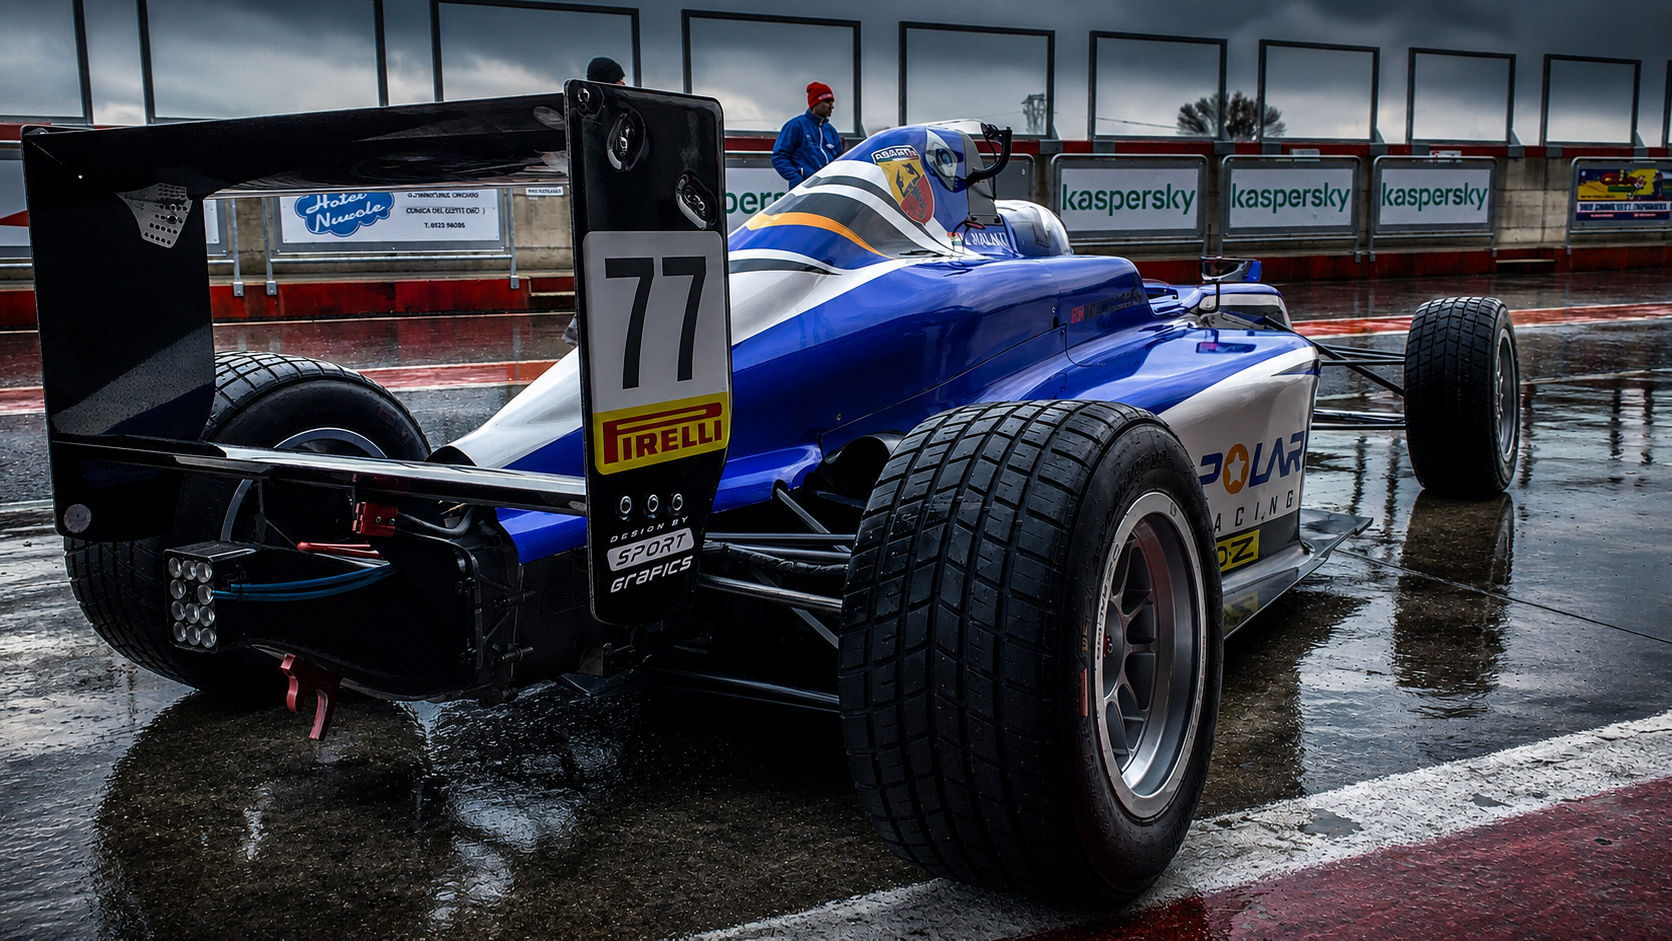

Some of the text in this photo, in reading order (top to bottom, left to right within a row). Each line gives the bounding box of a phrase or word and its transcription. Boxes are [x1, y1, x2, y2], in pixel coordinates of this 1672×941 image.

[1062, 183, 1196, 216] kaspersky
[1231, 182, 1351, 213] kaspersky
[1382, 182, 1488, 212] kaspersky
[604, 256, 706, 389] 77
[602, 401, 723, 465] PIRELLI
[1200, 430, 1305, 495] POLAR
[671, 515, 689, 527] BY
[1213, 490, 1294, 533] ACING
[615, 532, 687, 567] SPORT
